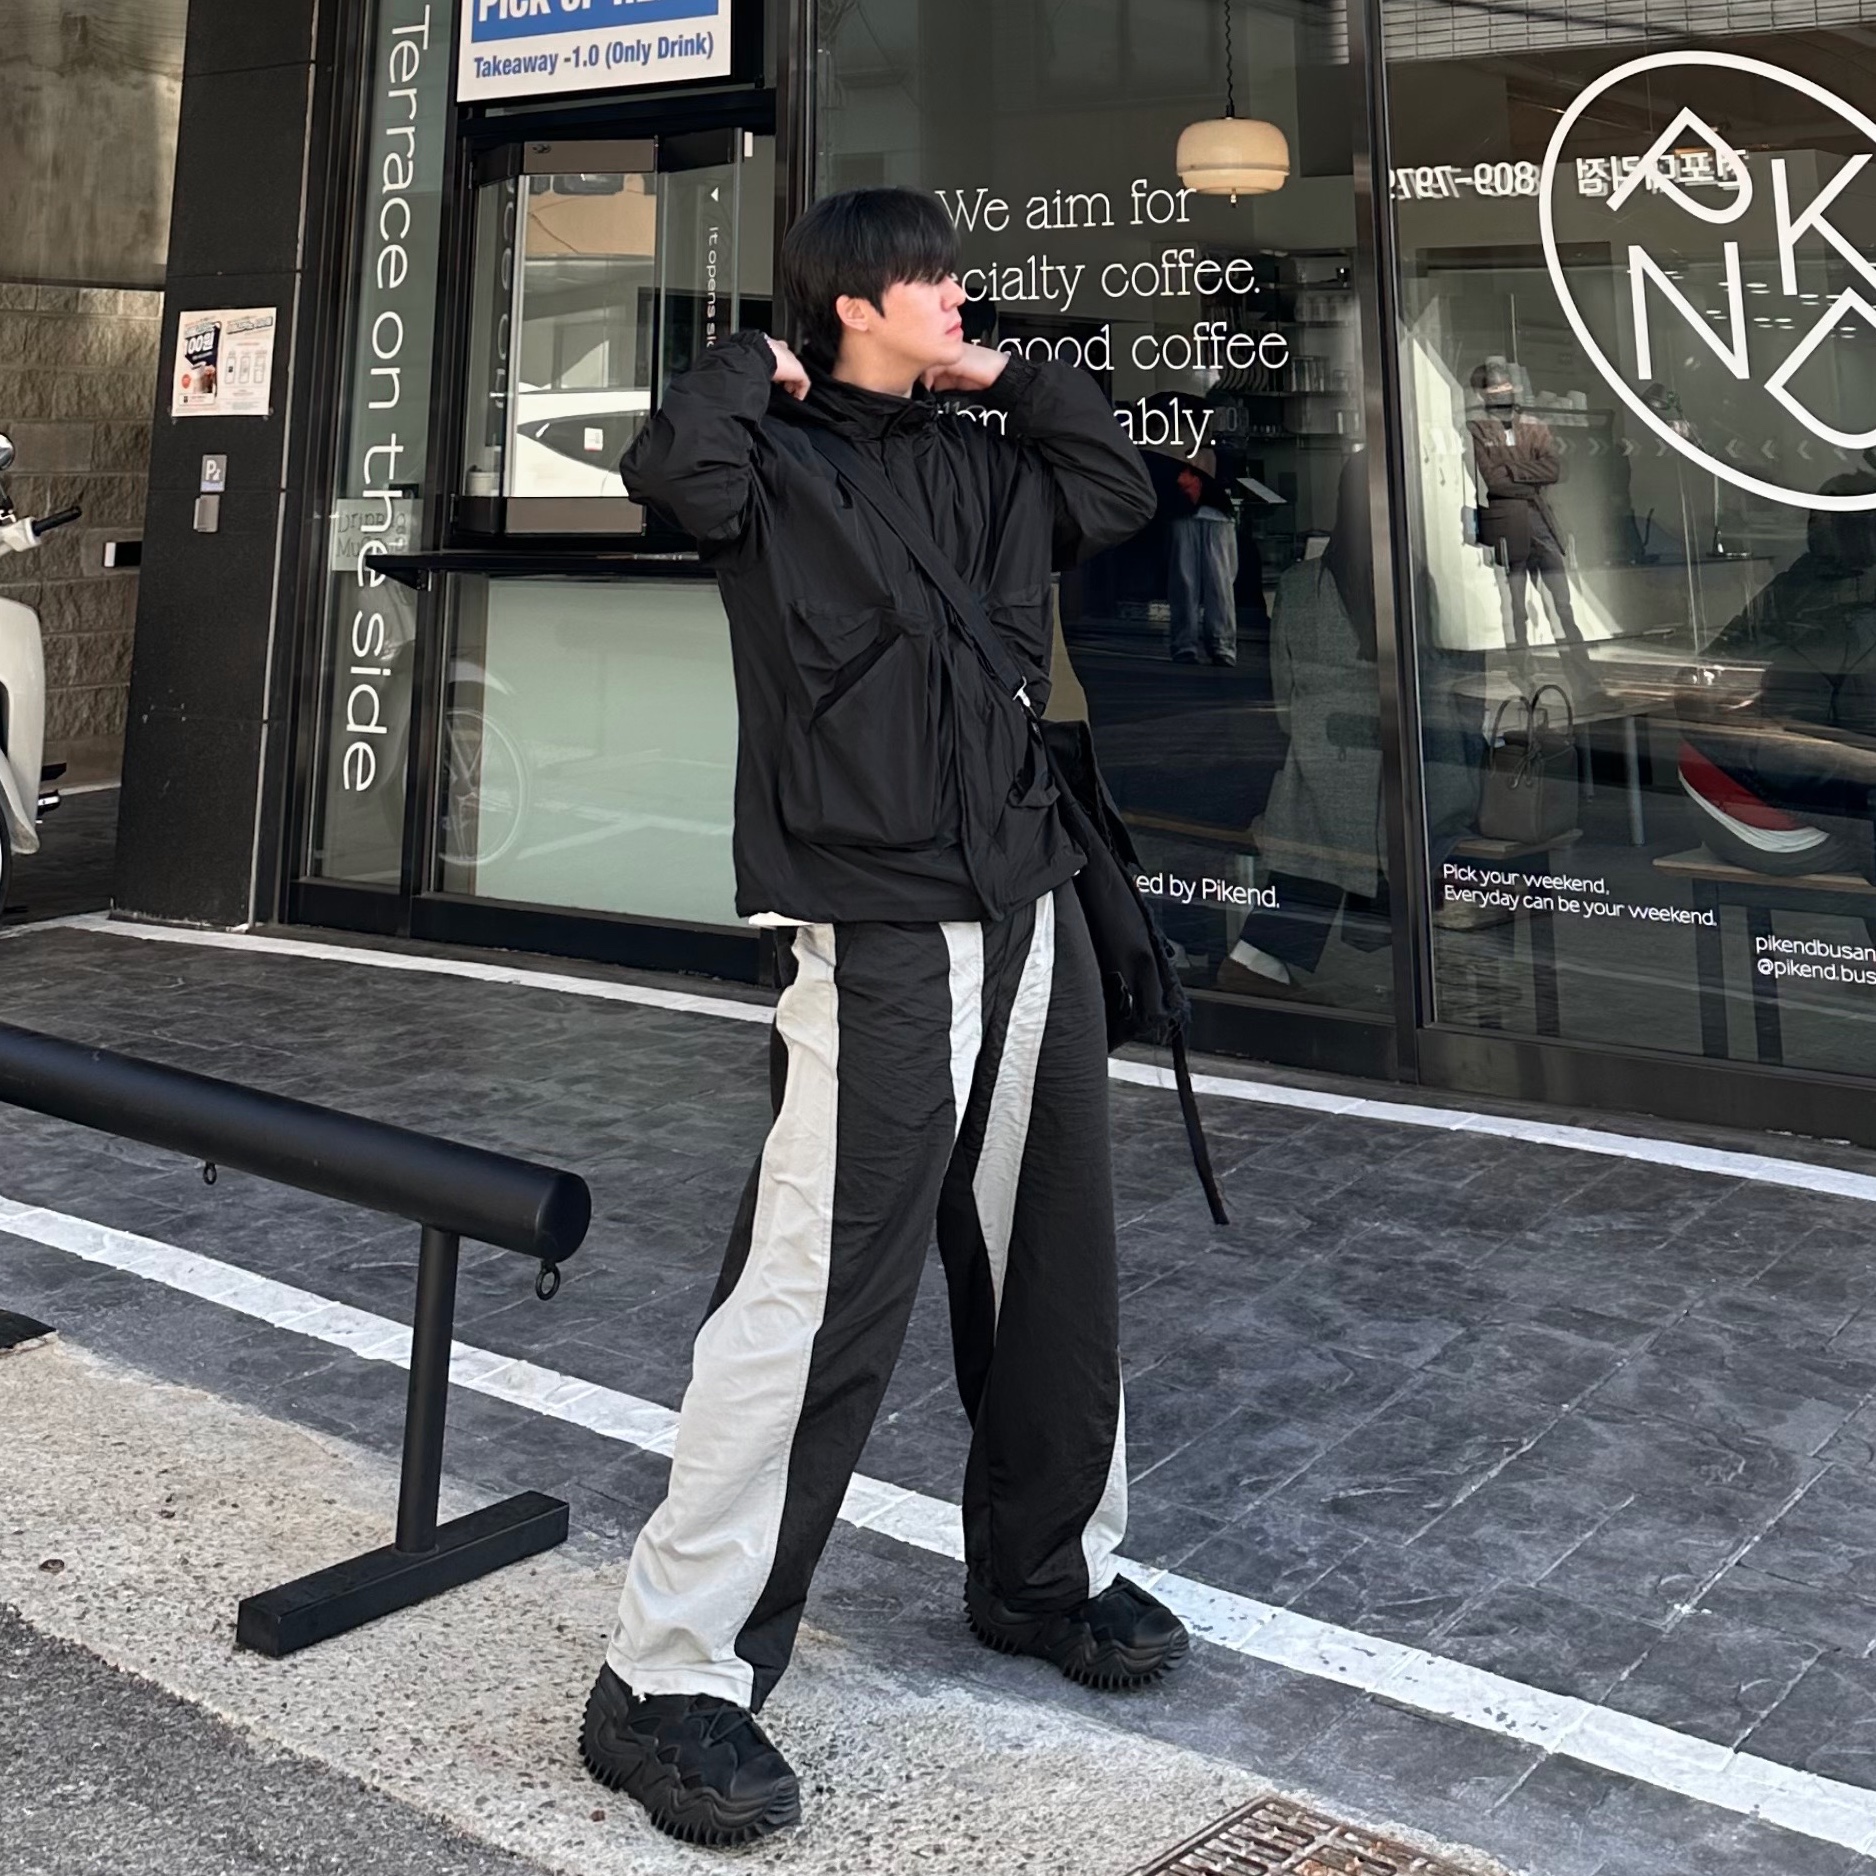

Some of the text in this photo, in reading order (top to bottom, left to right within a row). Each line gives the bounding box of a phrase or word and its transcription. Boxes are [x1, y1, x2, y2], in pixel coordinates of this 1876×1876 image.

[474, 31, 714, 79] Takeaway -1.0 (Only Drink)
[377, 4, 431, 290] Terrace
[935, 179, 1197, 232] We aim for
[706, 249, 717, 318] opens
[952, 248, 1261, 312] cialty coffee.
[368, 310, 404, 410] on
[1131, 321, 1290, 371] coffee
[357, 432, 404, 588] the
[343, 611, 392, 792] side
[1132, 872, 1281, 909] ed by Pikend.
[1443, 863, 1478, 882] Pick
[1480, 869, 1519, 887] your
[1444, 885, 1718, 928] Everyday can be your weekend.
